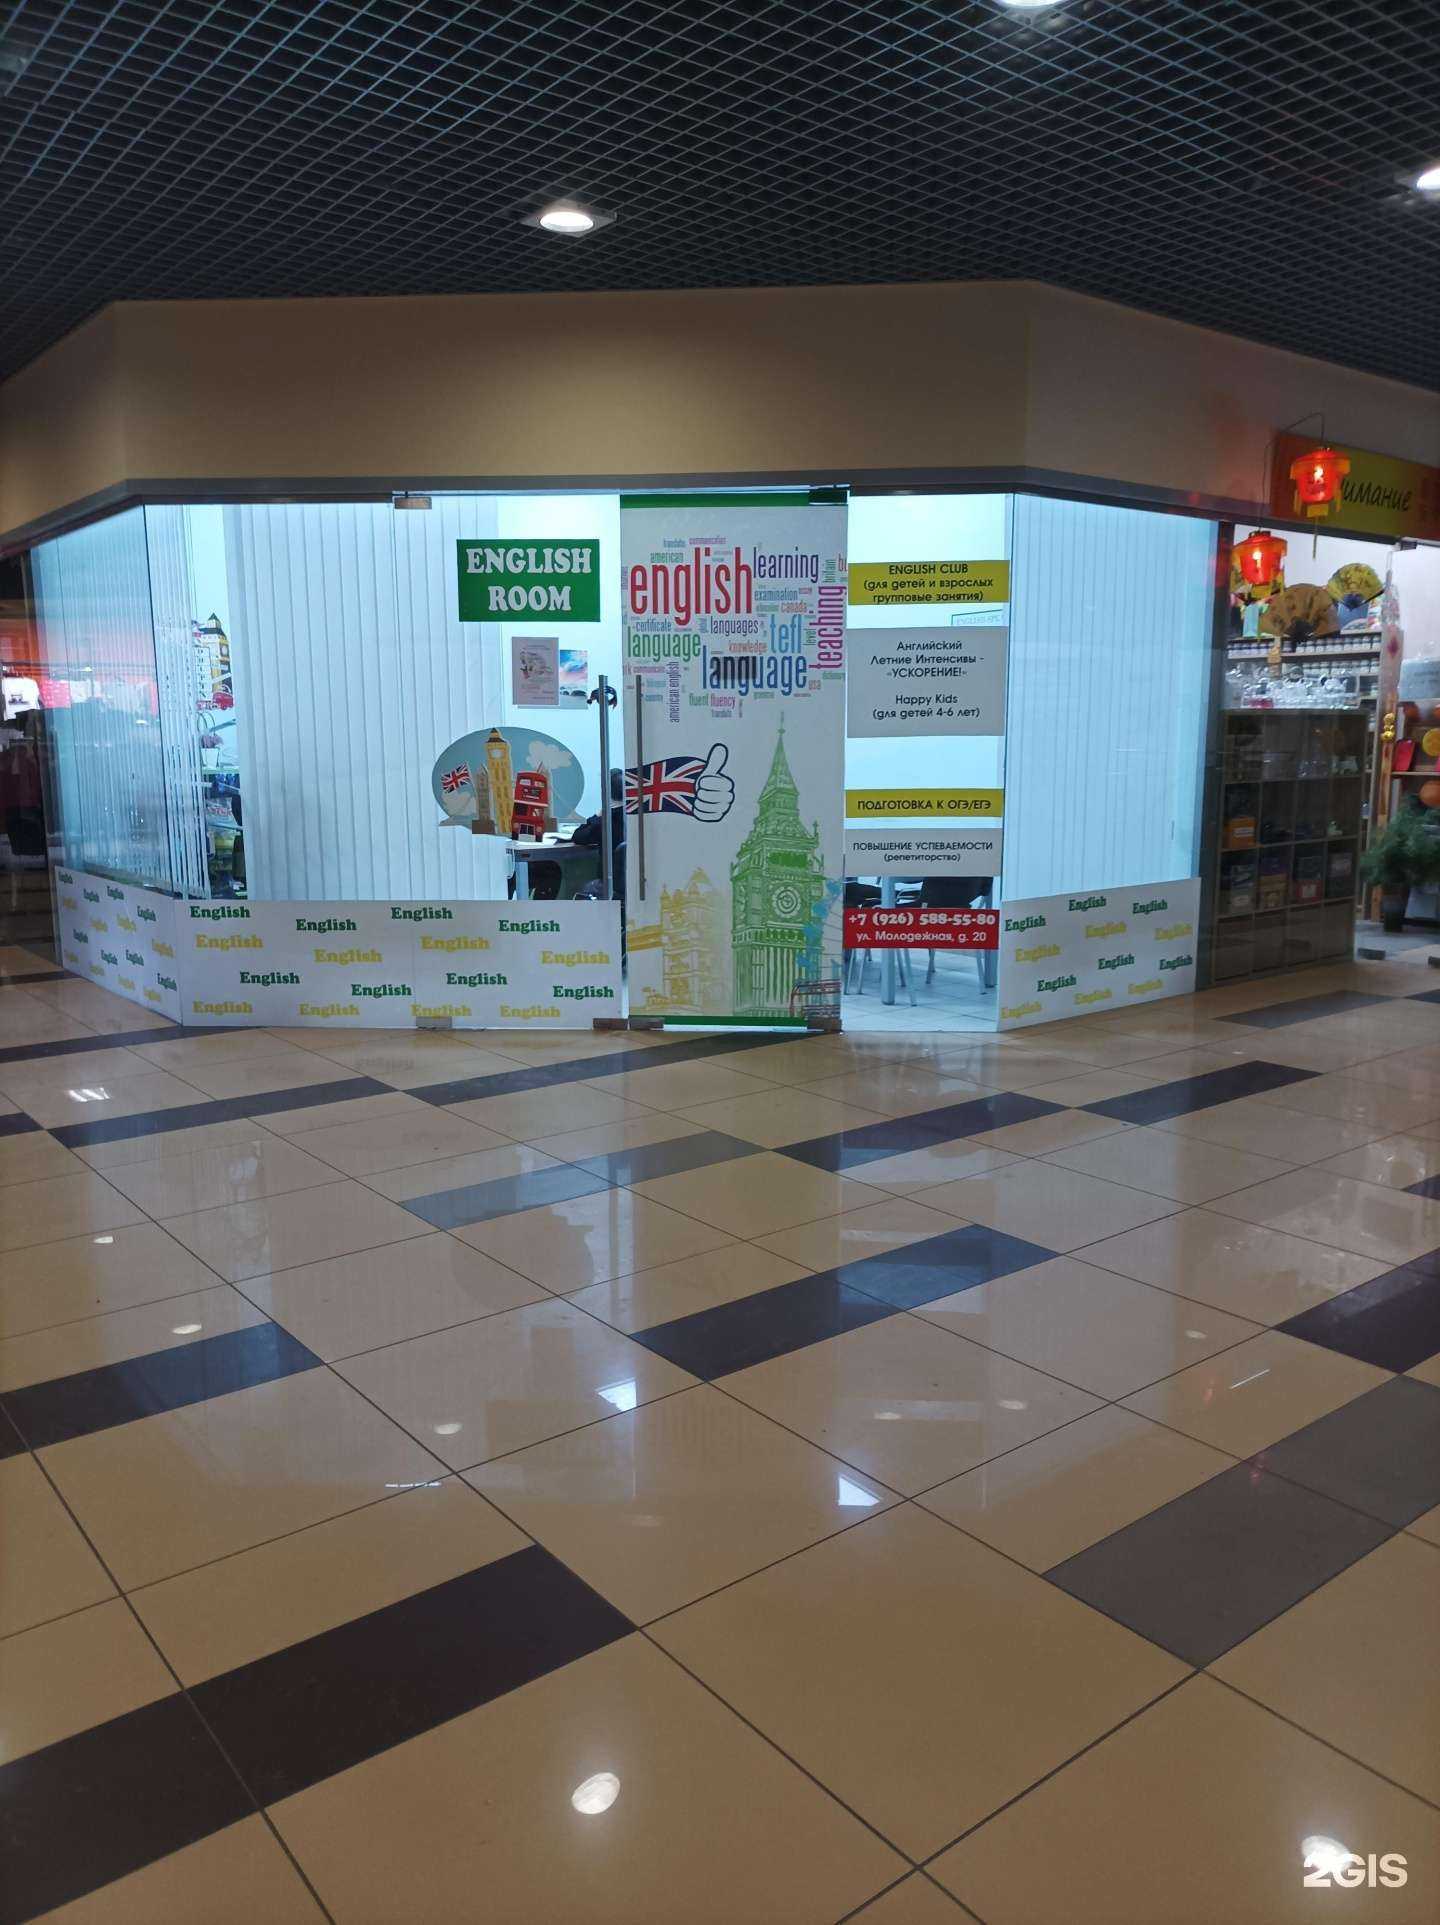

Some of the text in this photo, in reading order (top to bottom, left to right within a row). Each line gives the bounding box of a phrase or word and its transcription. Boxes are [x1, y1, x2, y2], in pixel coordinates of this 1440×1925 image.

[466, 548, 592, 574] ENGLISH
[753, 546, 819, 584] learning
[889, 563, 968, 575] ENGLISH CLUB
[630, 547, 752, 626] english
[864, 580, 889, 590] (для
[891, 578, 925, 590] детей
[939, 578, 993, 589] взрослых
[488, 585, 572, 611] ROOM
[873, 591, 984, 603] групповые занятия)
[635, 618, 672, 632] certificate
[710, 615, 759, 637] languages
[808, 585, 847, 669] teaching
[769, 614, 802, 654] tefl
[627, 626, 701, 662] language
[896, 640, 963, 651] Английский
[871, 655, 912, 665] Летние
[915, 654, 977, 664] Интенсивы
[702, 645, 807, 696] language
[666, 661, 681, 723] american english
[896, 694, 958, 706] Happy Kids
[873, 707, 980, 720] (для детей 4-6 лет)
[858, 799, 992, 810] ПОДГОТОВКА К ОГЭ/ЕГЭ
[853, 842, 993, 851] ПОВЫШЕНИЕ УСПЕВАЕМОСТИ
[884, 853, 961, 863] (репетиторство)
[1069, 896, 1107, 912] English
[1133, 899, 1168, 915] English
[190, 906, 250, 921] English
[391, 907, 453, 921] English
[849, 913, 996, 926] +7 (926) 588-55-80
[296, 919, 357, 933] English
[499, 920, 560, 934] English
[1005, 915, 1046, 932] English
[196, 935, 263, 951] English
[420, 936, 490, 952] English
[856, 932, 871, 942] ул.
[958, 933, 969, 943] д.
[972, 931, 987, 941] 20
[314, 949, 383, 965] English
[541, 951, 610, 967] English
[1098, 953, 1134, 970] English
[1159, 955, 1193, 970] English
[240, 972, 300, 986] English
[446, 973, 508, 987] English
[1037, 975, 1076, 992] English
[351, 984, 412, 998] English
[553, 985, 614, 1000] English
[192, 1001, 253, 1015] English
[300, 1003, 360, 1018] English
[500, 1005, 561, 1019] English
